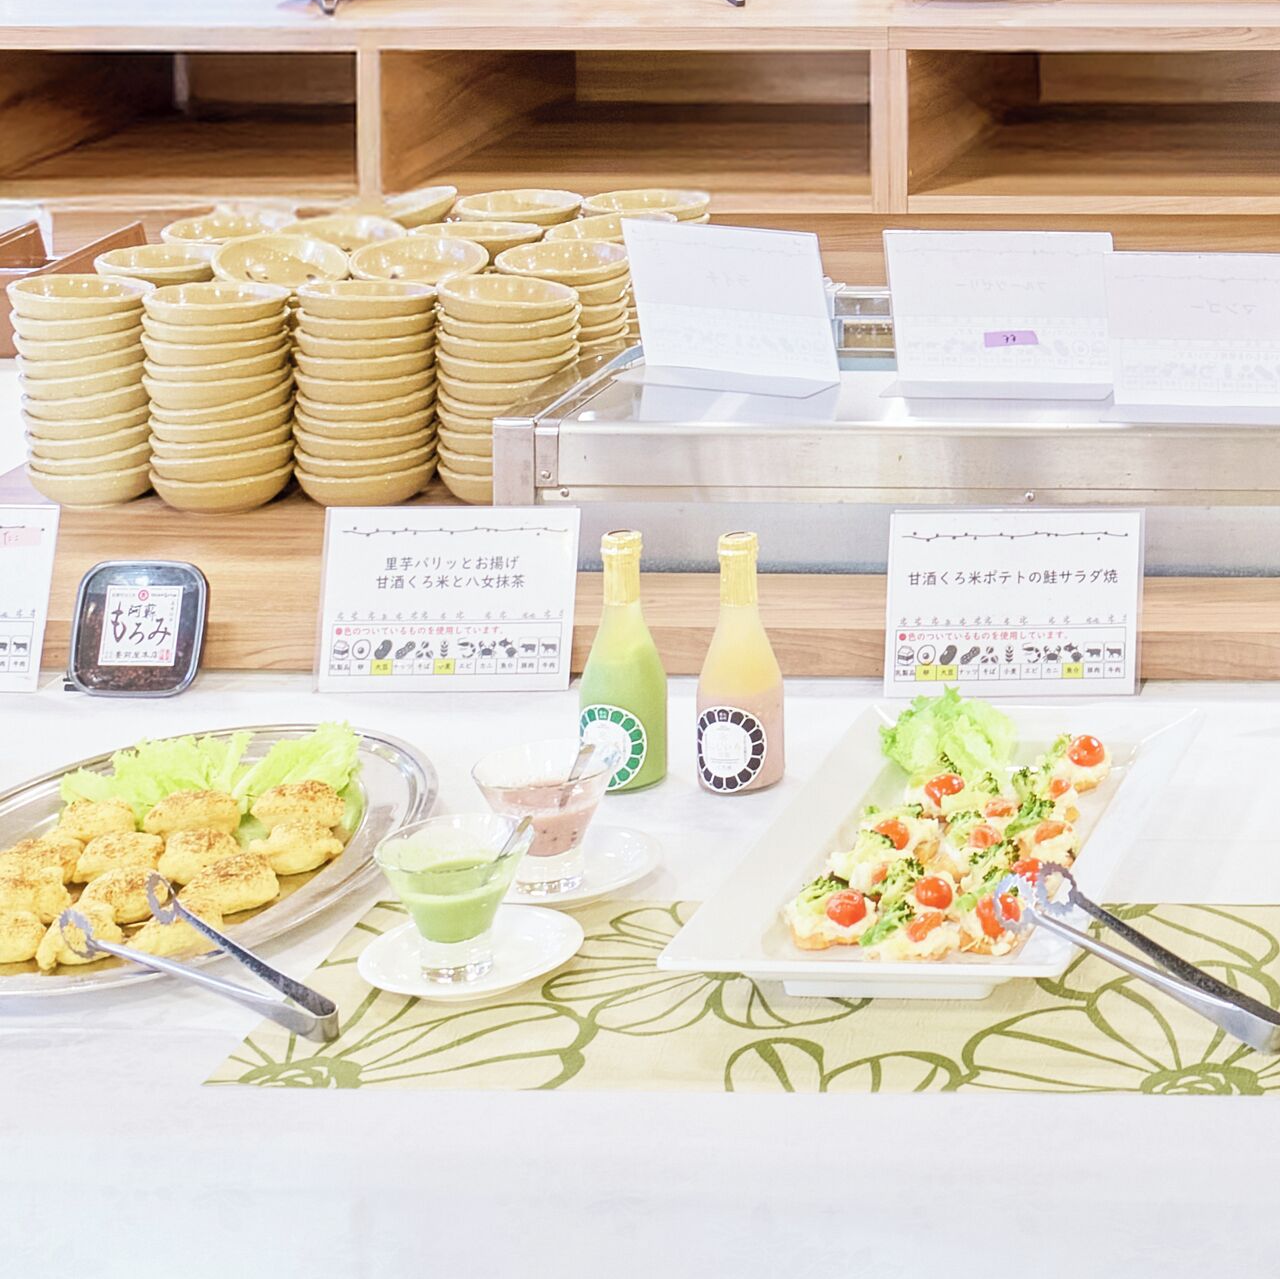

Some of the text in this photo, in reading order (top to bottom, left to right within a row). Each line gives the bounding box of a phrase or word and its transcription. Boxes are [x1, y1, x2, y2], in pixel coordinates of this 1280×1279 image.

[384, 555, 520, 572] 里芋パリッとお揚げ
[375, 573, 525, 590] 甘酒くろ米と八女抹茶
[907, 568, 1119, 586] 甘酒くろ米ポテトの鮭サラダ焼
[111, 600, 172, 646] もろみ
